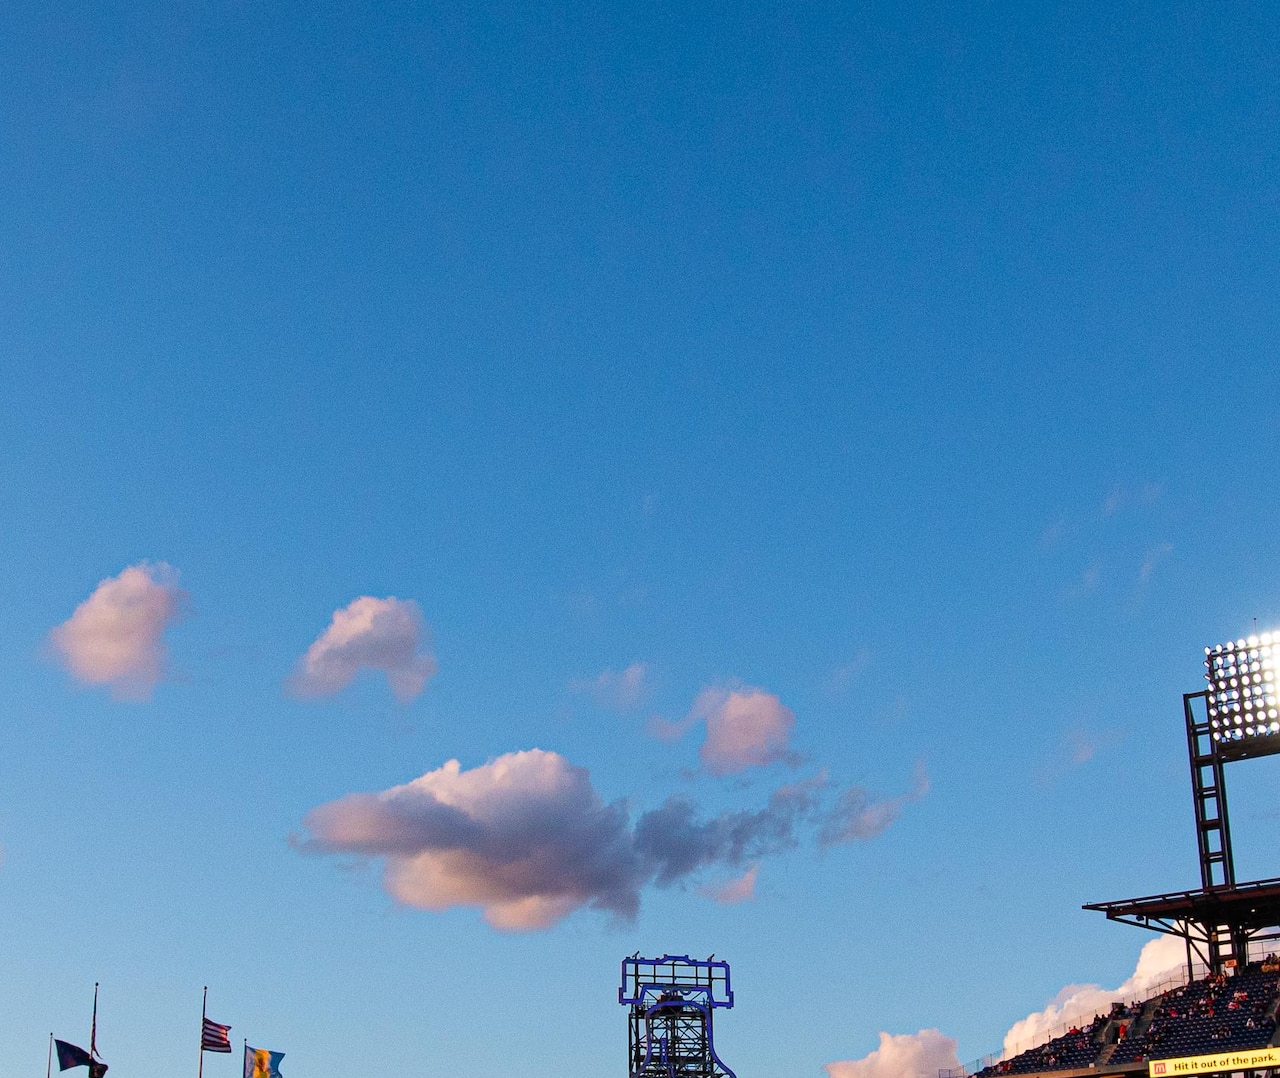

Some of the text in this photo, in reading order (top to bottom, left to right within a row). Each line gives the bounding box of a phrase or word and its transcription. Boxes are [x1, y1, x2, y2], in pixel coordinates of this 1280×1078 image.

[1174, 1063, 1188, 1072] Hit
[1200, 1060, 1217, 1069] out
[1219, 1058, 1231, 1068] of
[1231, 1056, 1247, 1067] the
[1249, 1054, 1277, 1068] park.
